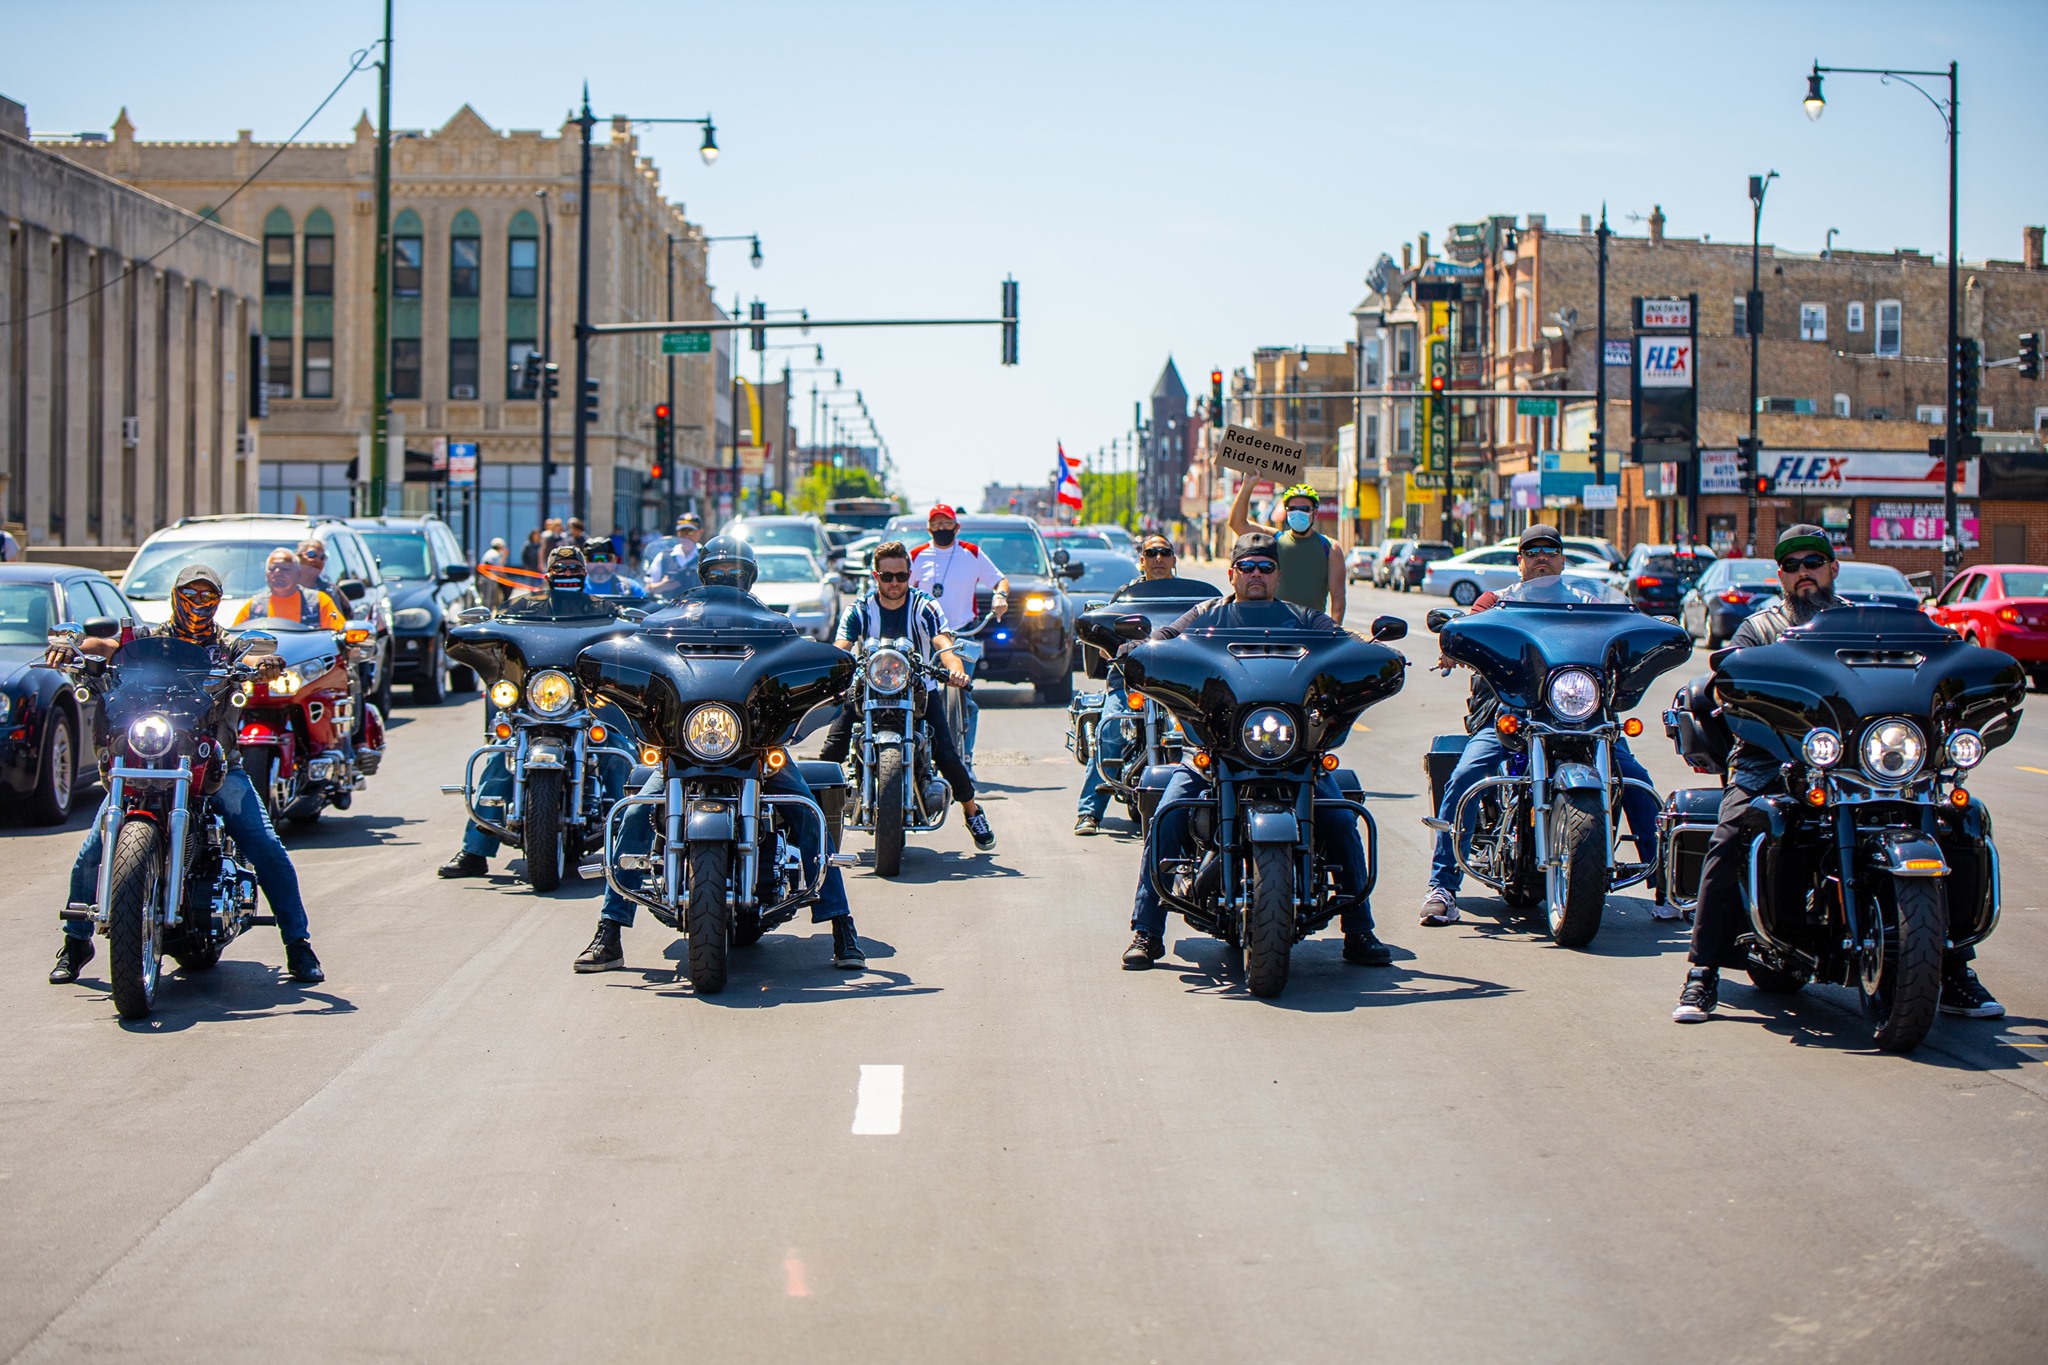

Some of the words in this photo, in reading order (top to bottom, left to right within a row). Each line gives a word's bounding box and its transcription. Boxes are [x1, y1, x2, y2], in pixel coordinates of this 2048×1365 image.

[1645, 346, 1688, 370] FLEX
[1226, 429, 1302, 459] Redeemed
[1222, 447, 1268, 468] Riders
[1272, 460, 1297, 476] MM
[1714, 465, 1736, 475] AUTO
[1773, 456, 1848, 480] FLEX
[1914, 517, 1927, 539] 6
